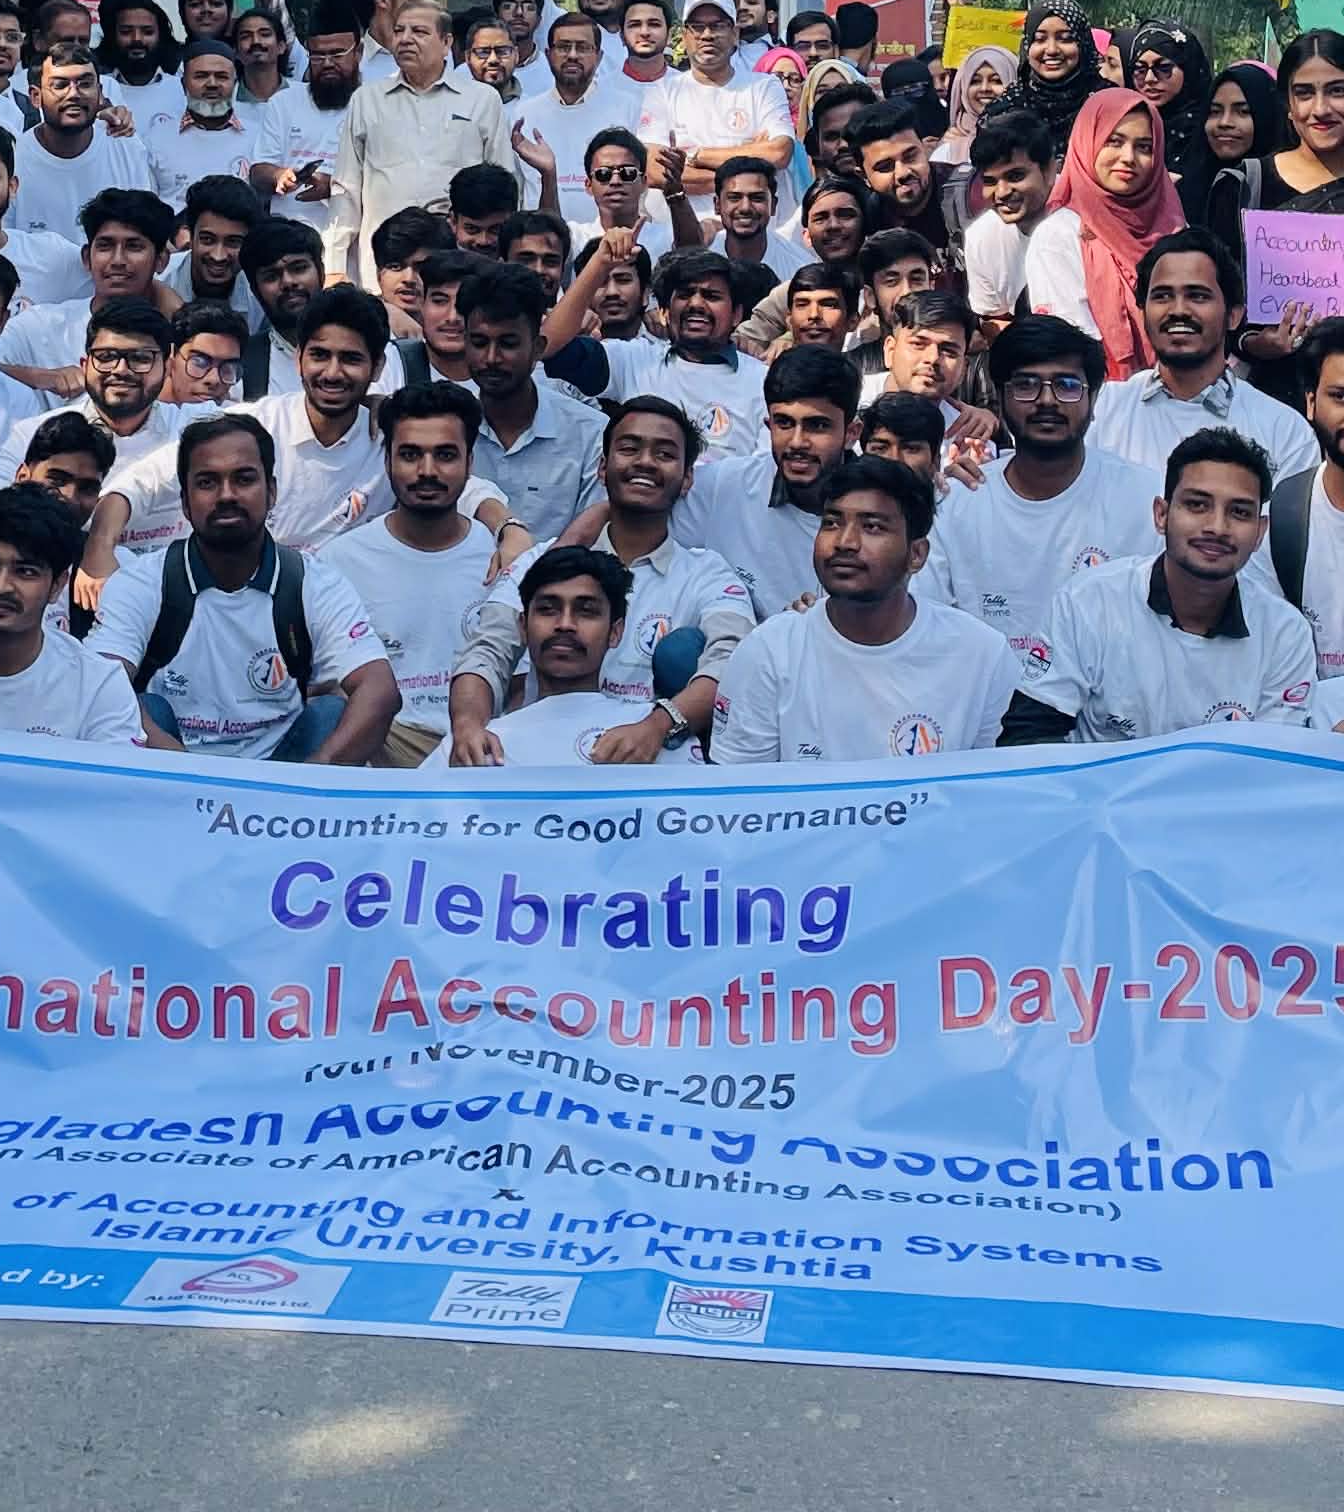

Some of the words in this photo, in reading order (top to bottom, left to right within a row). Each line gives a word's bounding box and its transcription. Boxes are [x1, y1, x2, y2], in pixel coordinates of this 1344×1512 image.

[1260, 260, 1342, 289] Heartbeat
[736, 566, 758, 585] Tally
[982, 593, 1008, 606] Tally
[983, 609, 1010, 617] Prime
[797, 743, 823, 758] Tally
[461, 810, 521, 838] for
[532, 808, 644, 843] Good
[269, 859, 854, 954] Celebrating
[370, 958, 899, 1056] Accounting
[303, 1090, 758, 1166] Accounting
[779, 1136, 1275, 1192] Association
[37, 1145, 257, 1169] Associate
[267, 1152, 319, 1172] of
[321, 1140, 534, 1173] American
[543, 1143, 811, 1202] Accounting
[823, 1182, 1124, 1223] Association)
[11, 1191, 80, 1211] of
[75, 1191, 406, 1229] Accounting
[421, 1207, 532, 1232] and
[548, 1208, 883, 1253] Information
[903, 1233, 1165, 1274] Systems
[89, 1217, 298, 1246] Islamic
[315, 1217, 620, 1267] University,
[643, 1237, 873, 1281] Kushtia
[38, 1267, 107, 1290] by:
[455, 1278, 564, 1306] Tally
[187, 1293, 278, 1307] Composite
[280, 1299, 314, 1309] Ltd.
[443, 1303, 562, 1323] Prime
